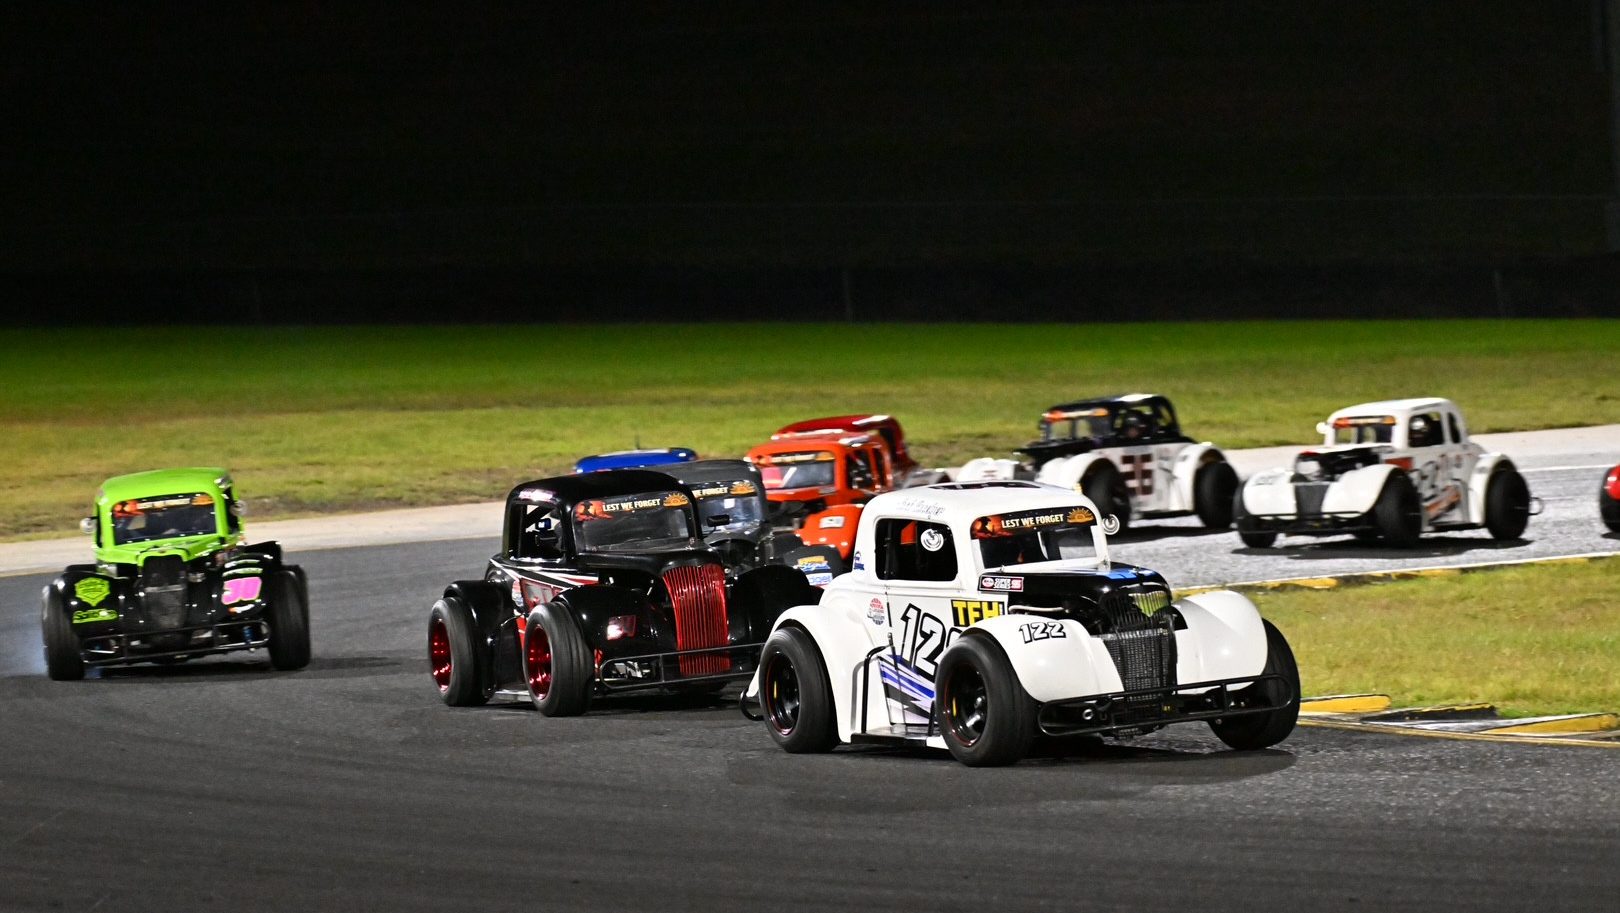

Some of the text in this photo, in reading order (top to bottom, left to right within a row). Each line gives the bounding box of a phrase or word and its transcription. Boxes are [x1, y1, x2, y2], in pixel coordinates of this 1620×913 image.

[602, 498, 661, 512] LEST WE FORGET
[1001, 514, 1064, 529] LEST WE FORGET
[1018, 621, 1067, 644] 122
